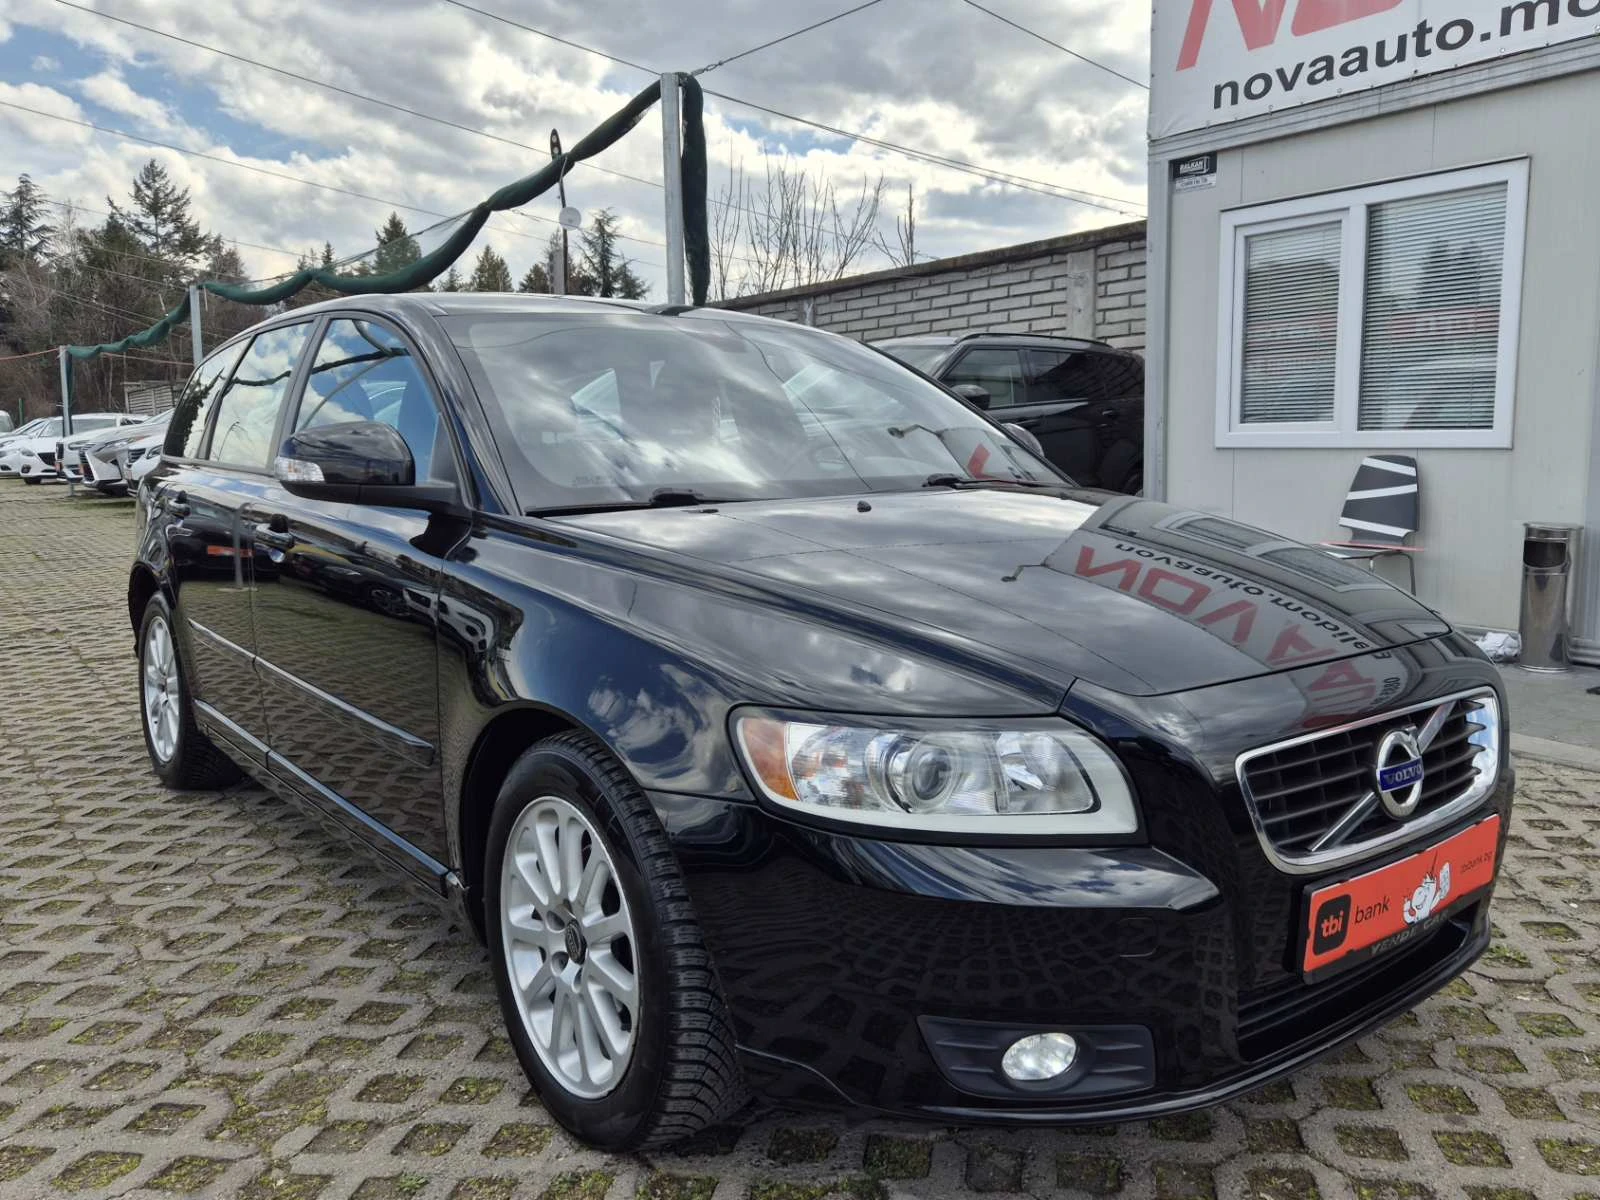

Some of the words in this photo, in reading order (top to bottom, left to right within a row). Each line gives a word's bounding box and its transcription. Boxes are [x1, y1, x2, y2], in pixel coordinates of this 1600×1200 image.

[1382, 763, 1423, 785] VOLVO
[1321, 910, 1344, 937] tbi
[1354, 895, 1390, 924] bank
